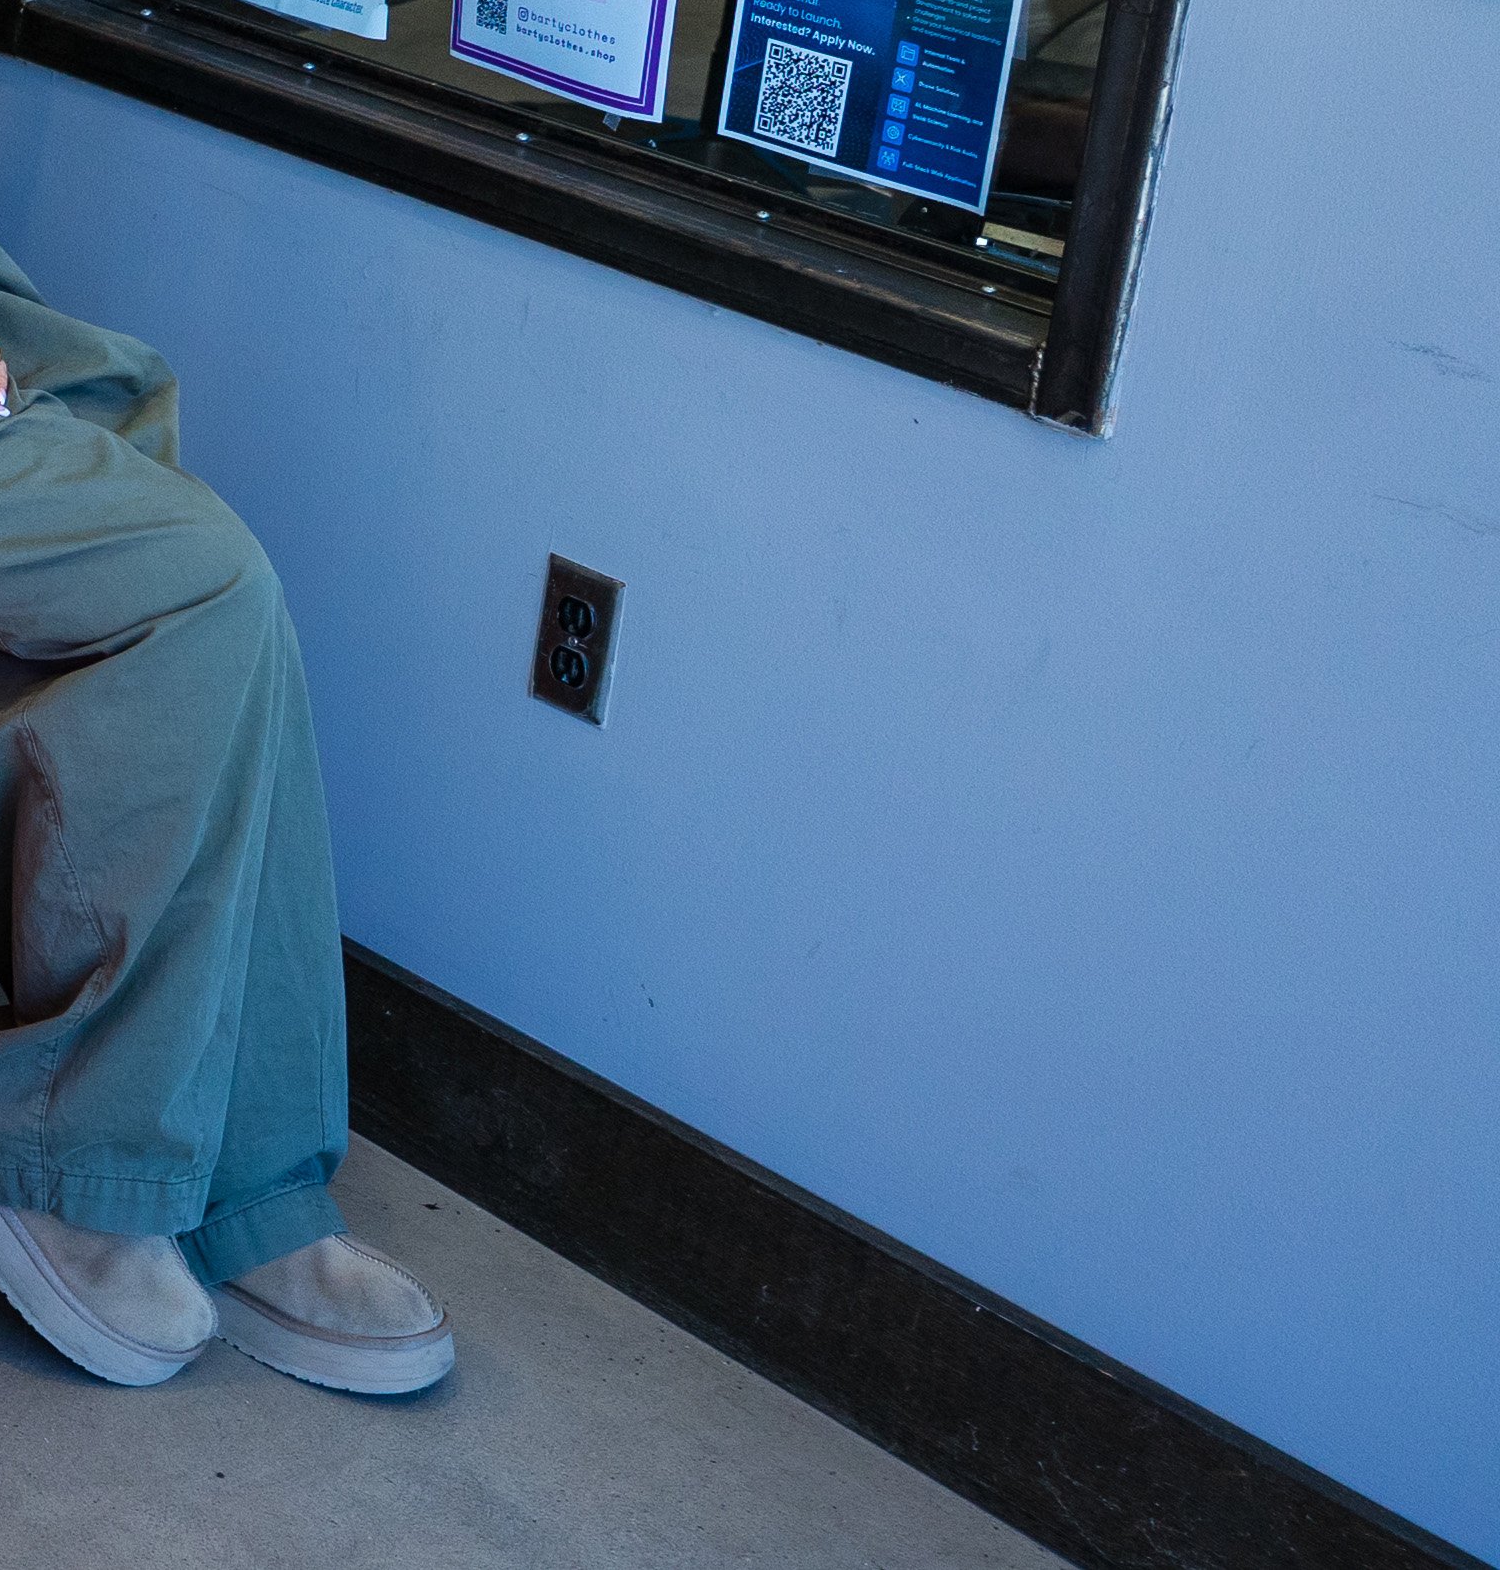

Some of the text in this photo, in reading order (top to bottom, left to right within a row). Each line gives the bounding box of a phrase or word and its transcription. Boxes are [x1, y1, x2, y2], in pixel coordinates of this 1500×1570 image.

[530, 10, 616, 48] bartyclothes
[749, 12, 876, 58] Interested? Apply Now.
[787, 5, 799, 18] to
[800, 8, 843, 30] Launch.
[515, 23, 616, 63] bartyclothes.shop
